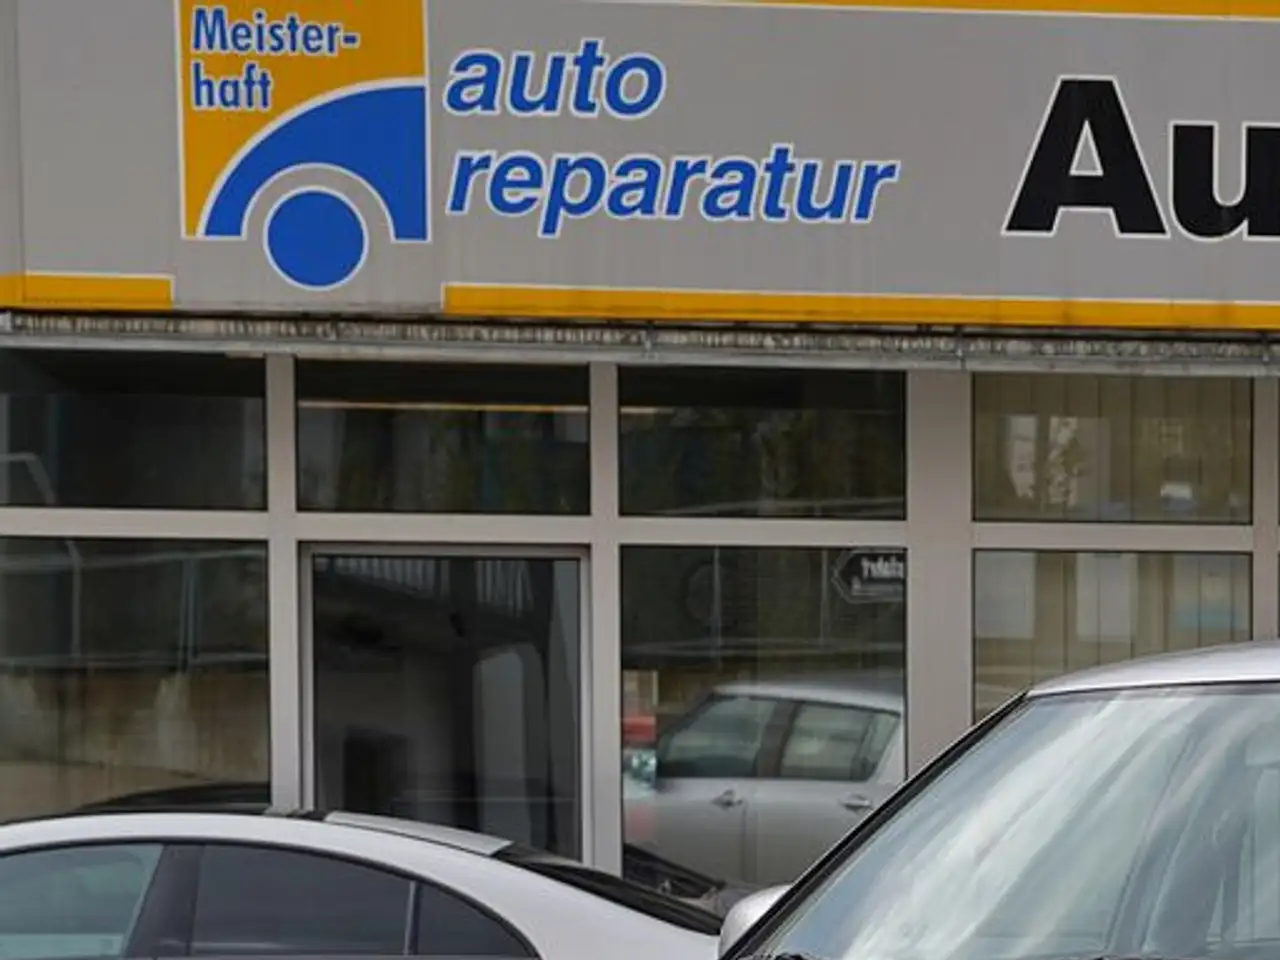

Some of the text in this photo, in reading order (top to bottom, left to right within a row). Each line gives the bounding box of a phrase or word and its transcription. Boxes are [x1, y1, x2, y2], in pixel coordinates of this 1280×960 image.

[191, 6, 360, 58] Meister-
[191, 60, 273, 112] haft
[443, 38, 666, 118] auto
[446, 143, 900, 240] reparatur
